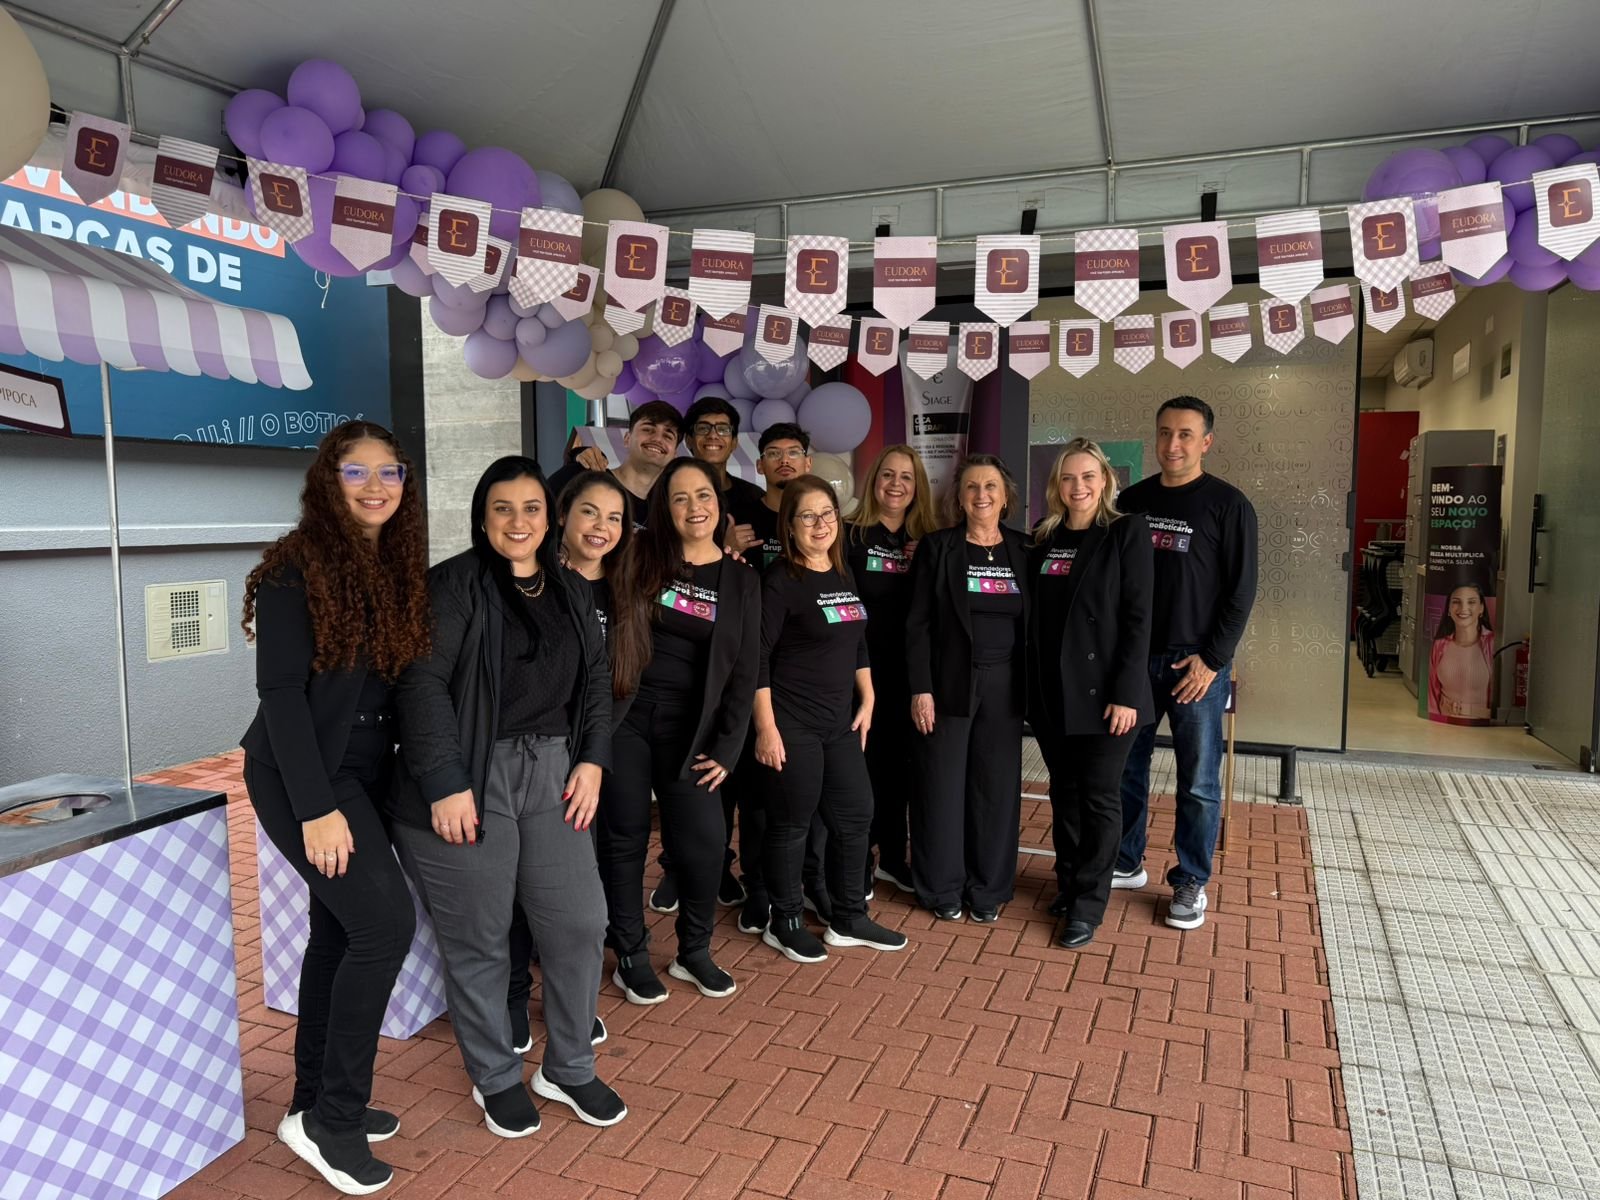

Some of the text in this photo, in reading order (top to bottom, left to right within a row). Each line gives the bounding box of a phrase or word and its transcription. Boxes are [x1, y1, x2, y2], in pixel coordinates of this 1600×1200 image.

[163, 164, 203, 183] EUDORA
[343, 205, 385, 222] EUDORA
[1452, 213, 1497, 229] EUDORA
[529, 237, 572, 253] EUDORA
[1269, 240, 1313, 255] EUDORA
[187, 244, 242, 291] DE
[701, 257, 745, 271] EUDORA
[1086, 258, 1130, 269] EUDORA
[884, 266, 928, 277] EUDORA
[816, 330, 844, 340] EUDORA
[914, 339, 943, 347] EUDORA
[1016, 339, 1044, 347] EUDORA
[0, 387, 37, 408] IPOCA
[1431, 483, 1454, 492] BEM-
[1431, 495, 1487, 504] VINDO AO
[1431, 507, 1488, 516] SEU NOVO
[1431, 519, 1476, 530] ESPAÇO!
